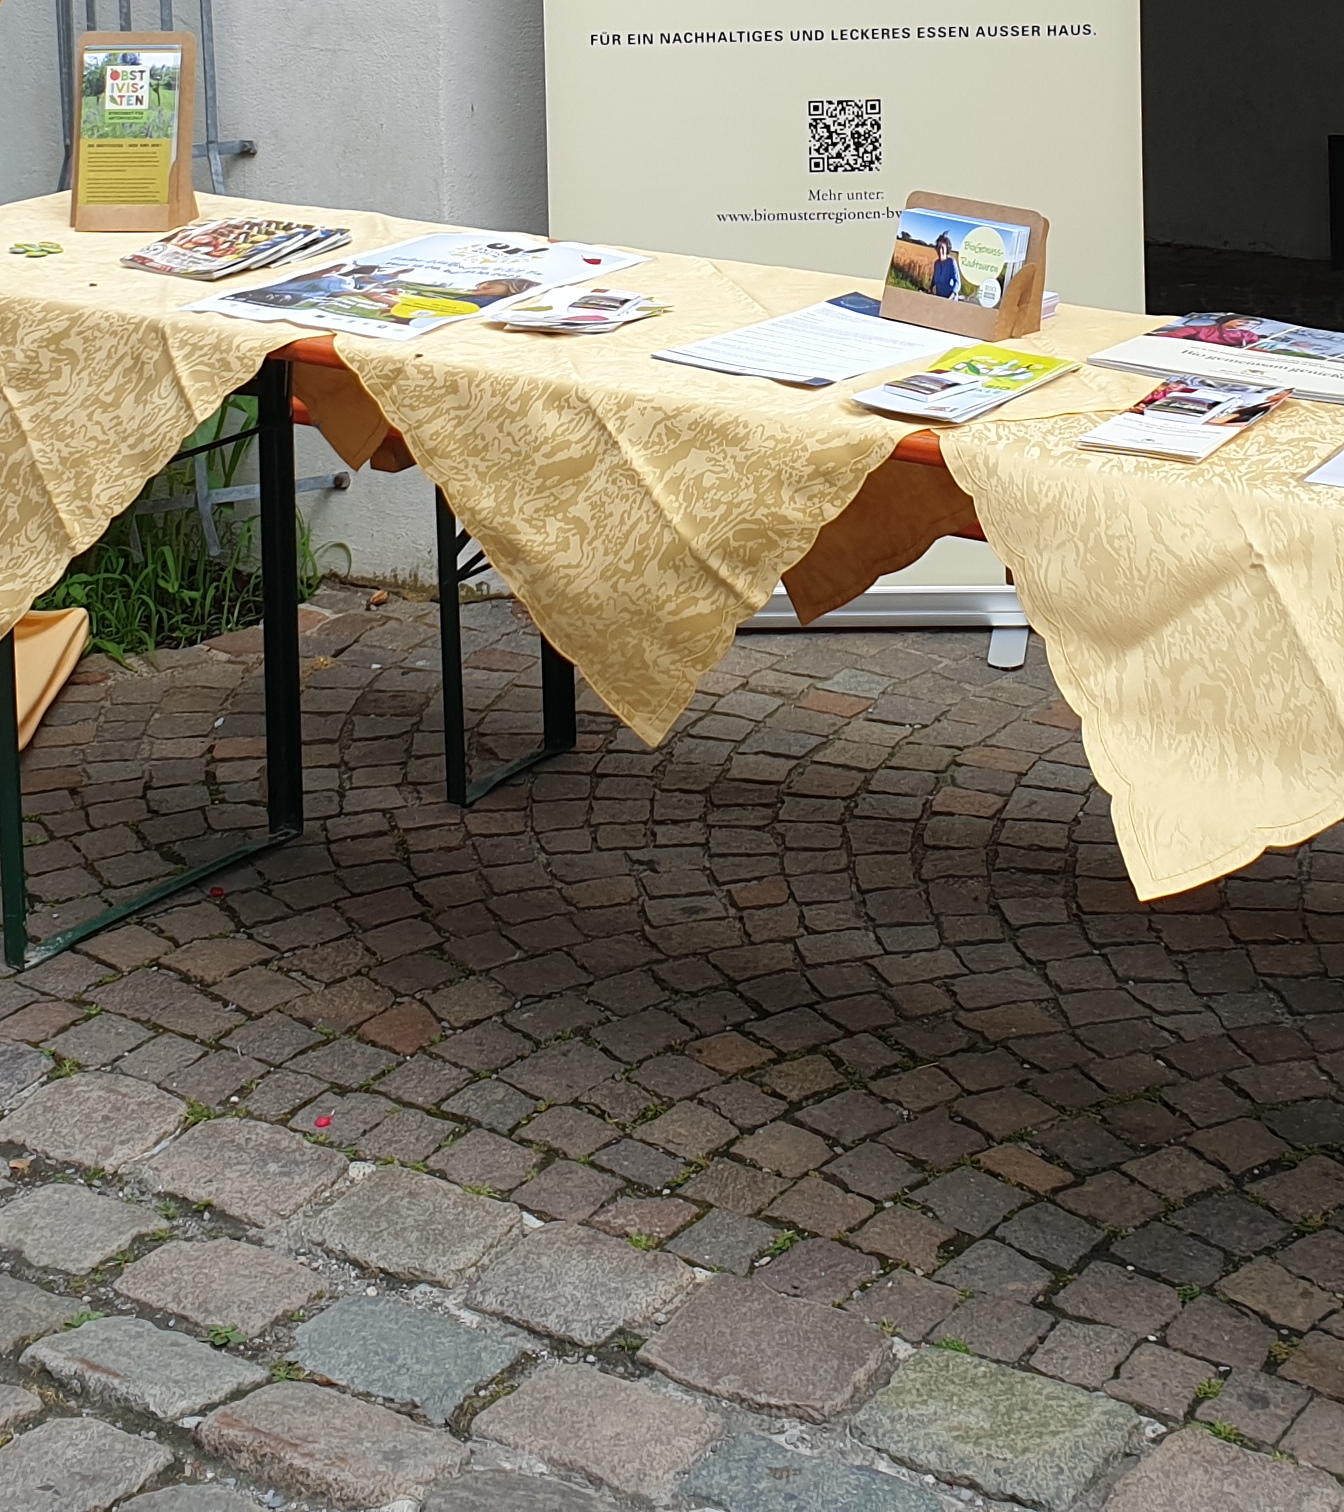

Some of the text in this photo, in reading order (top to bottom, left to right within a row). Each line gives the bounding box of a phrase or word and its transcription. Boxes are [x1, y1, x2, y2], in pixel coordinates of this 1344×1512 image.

[589, 22, 1097, 47] FÜR EIN NACHHALTIGES UND LECKERES ESSEN AUSSER HAUS.
[807, 187, 885, 202] Mehr unter:
[960, 256, 999, 273] Radtouren
